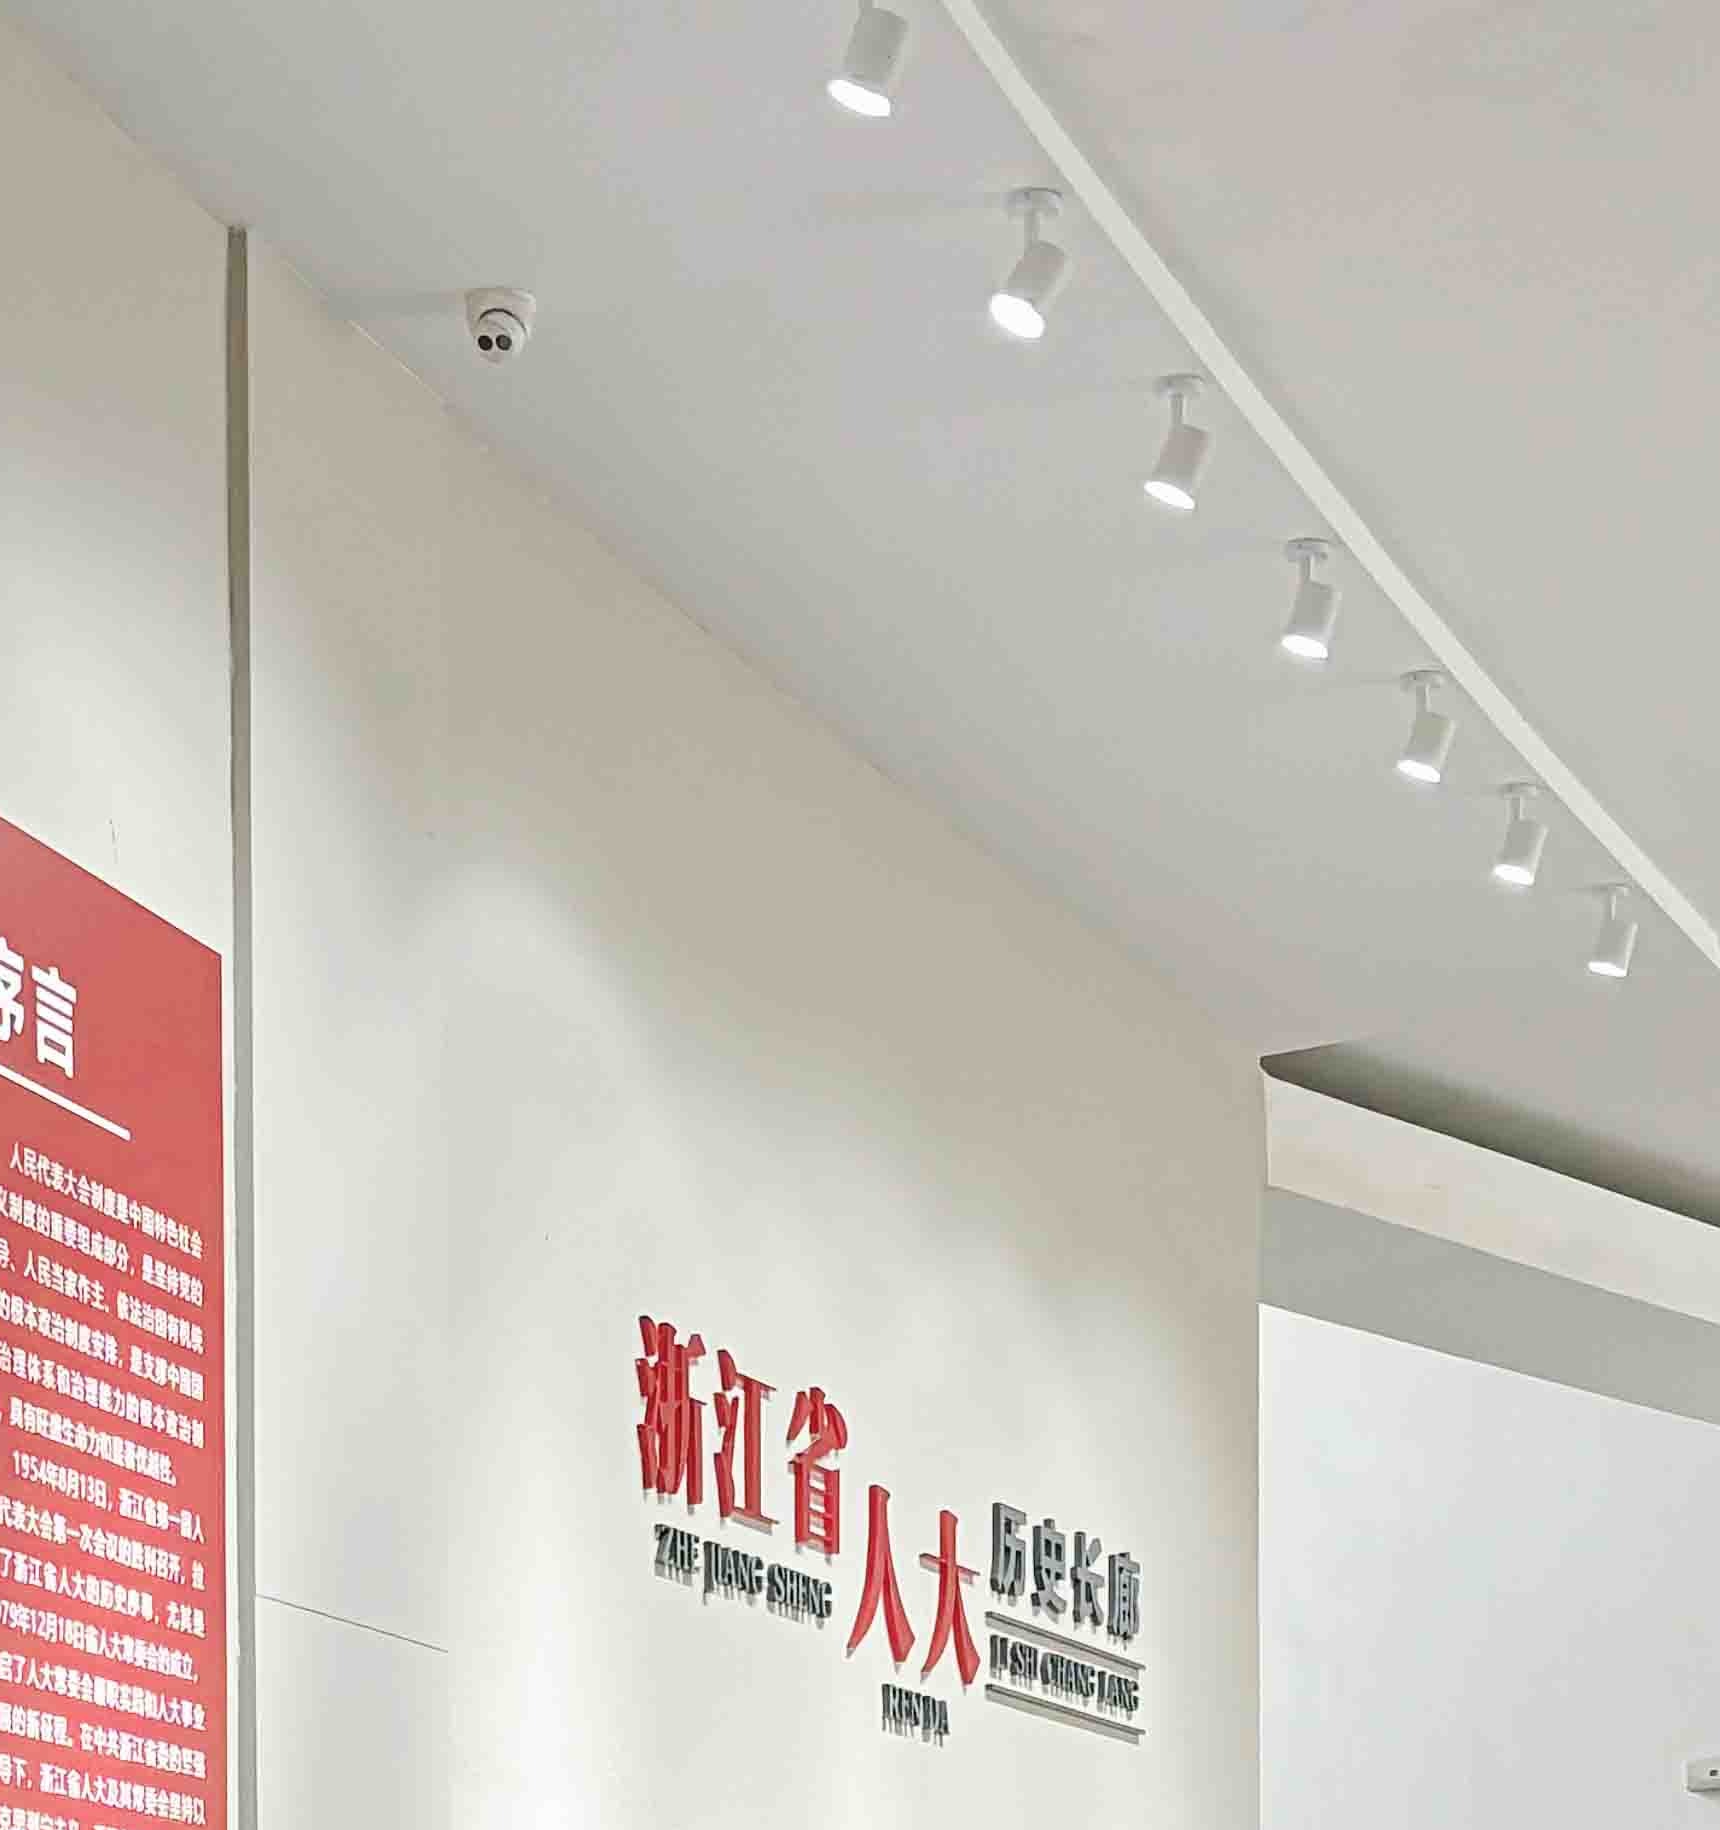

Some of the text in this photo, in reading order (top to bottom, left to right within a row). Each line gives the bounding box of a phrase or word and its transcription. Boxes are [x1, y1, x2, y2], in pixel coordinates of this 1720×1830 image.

[636, 1315, 848, 1558] 浙江省
[989, 1502, 1140, 1642] 历史长廊
